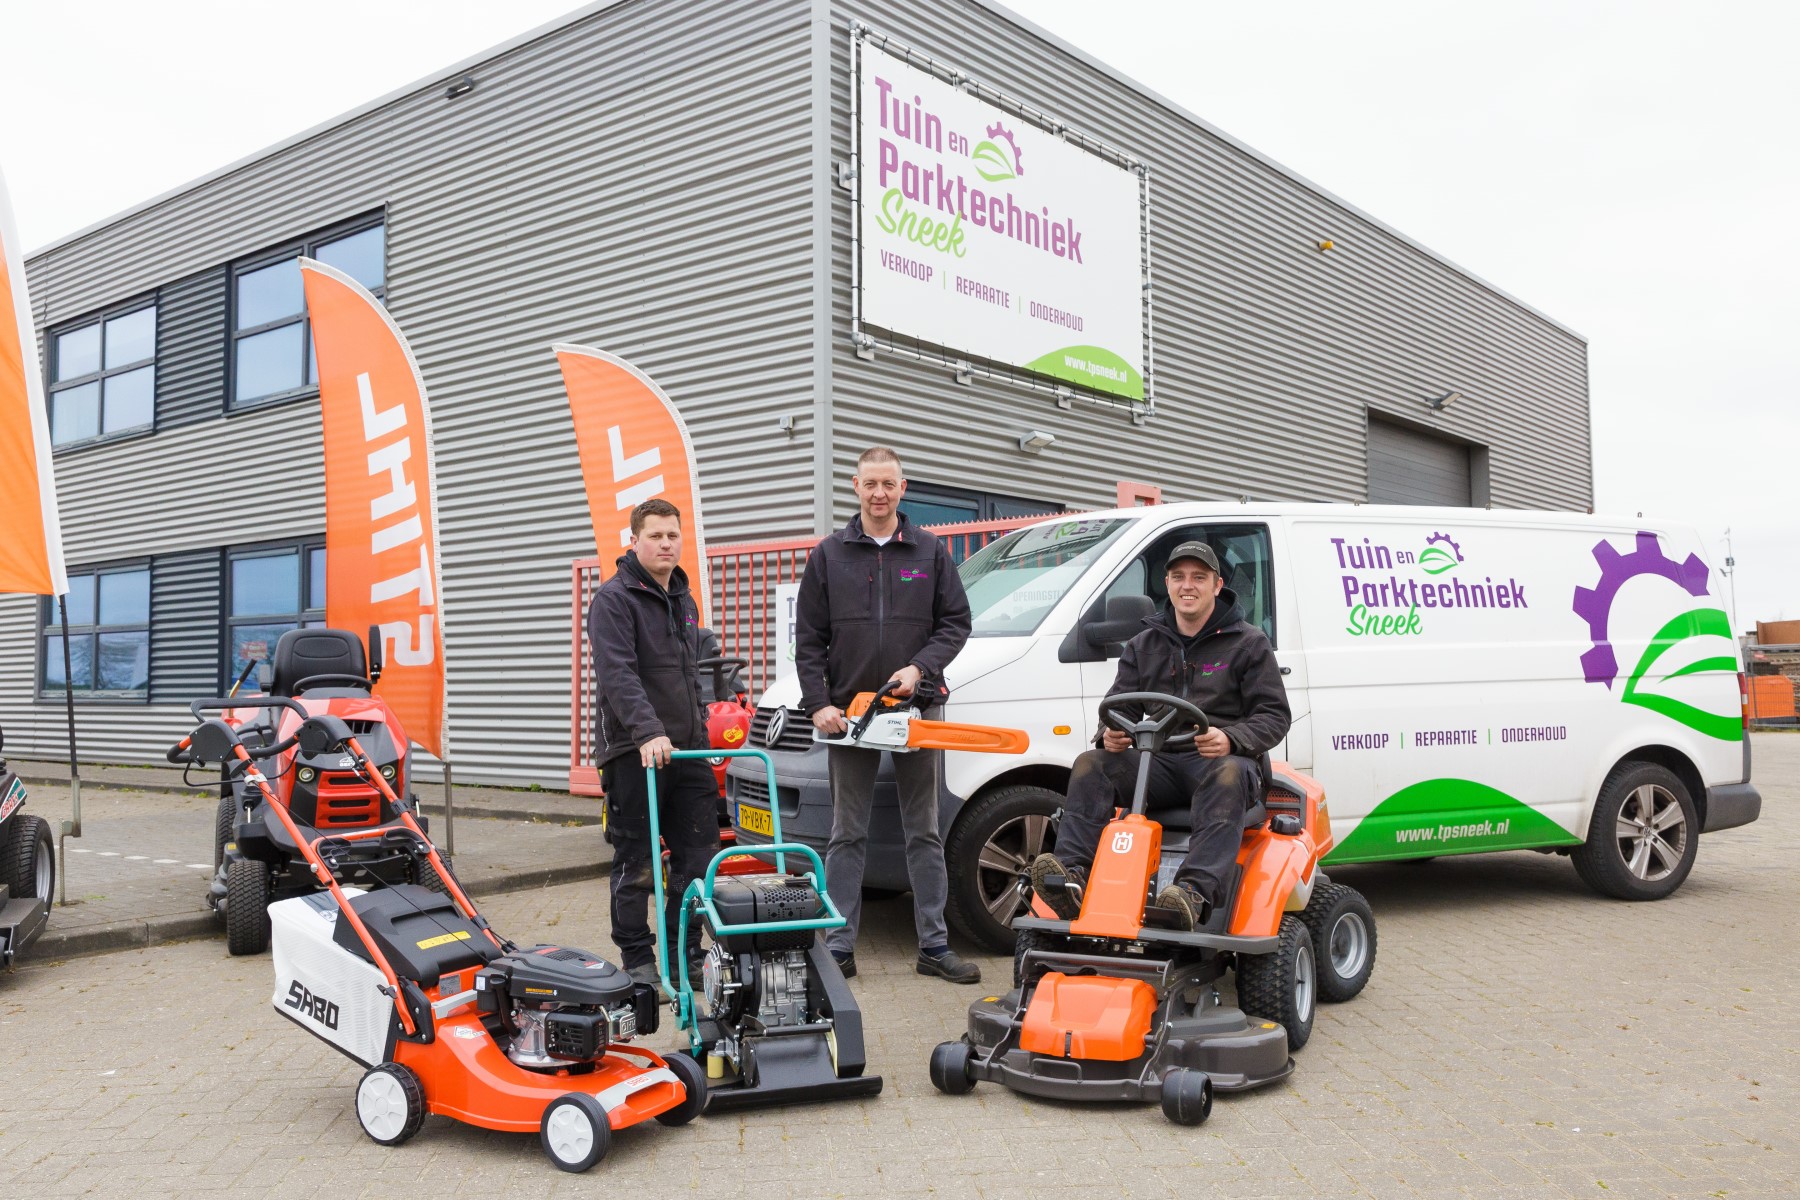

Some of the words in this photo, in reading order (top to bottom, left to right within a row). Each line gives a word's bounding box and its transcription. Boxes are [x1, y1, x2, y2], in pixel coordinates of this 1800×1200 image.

[875, 76, 942, 154] Tuin
[948, 131, 969, 157] en
[879, 138, 1083, 265] Parktechniek
[875, 187, 966, 258] Sneek
[880, 249, 934, 283] VERKOOP
[956, 275, 1010, 309] REPARATIE
[1030, 300, 1084, 333] ONDERHOUD
[1064, 353, 1128, 384] www.tpsneek.nl
[1330, 537, 1393, 570] Tuin
[1396, 551, 1415, 565] en
[1341, 575, 1529, 609] Parktechniek
[1345, 602, 1423, 636] Sneek
[1332, 733, 1390, 751] VERKOOP
[1415, 729, 1478, 747] REPARATIE
[1501, 725, 1567, 743] ONDERHOUD
[740, 807, 771, 832] 79-VBK-7
[1395, 818, 1510, 843] www.tpsneek.nl
[284, 979, 340, 1031] SABO
